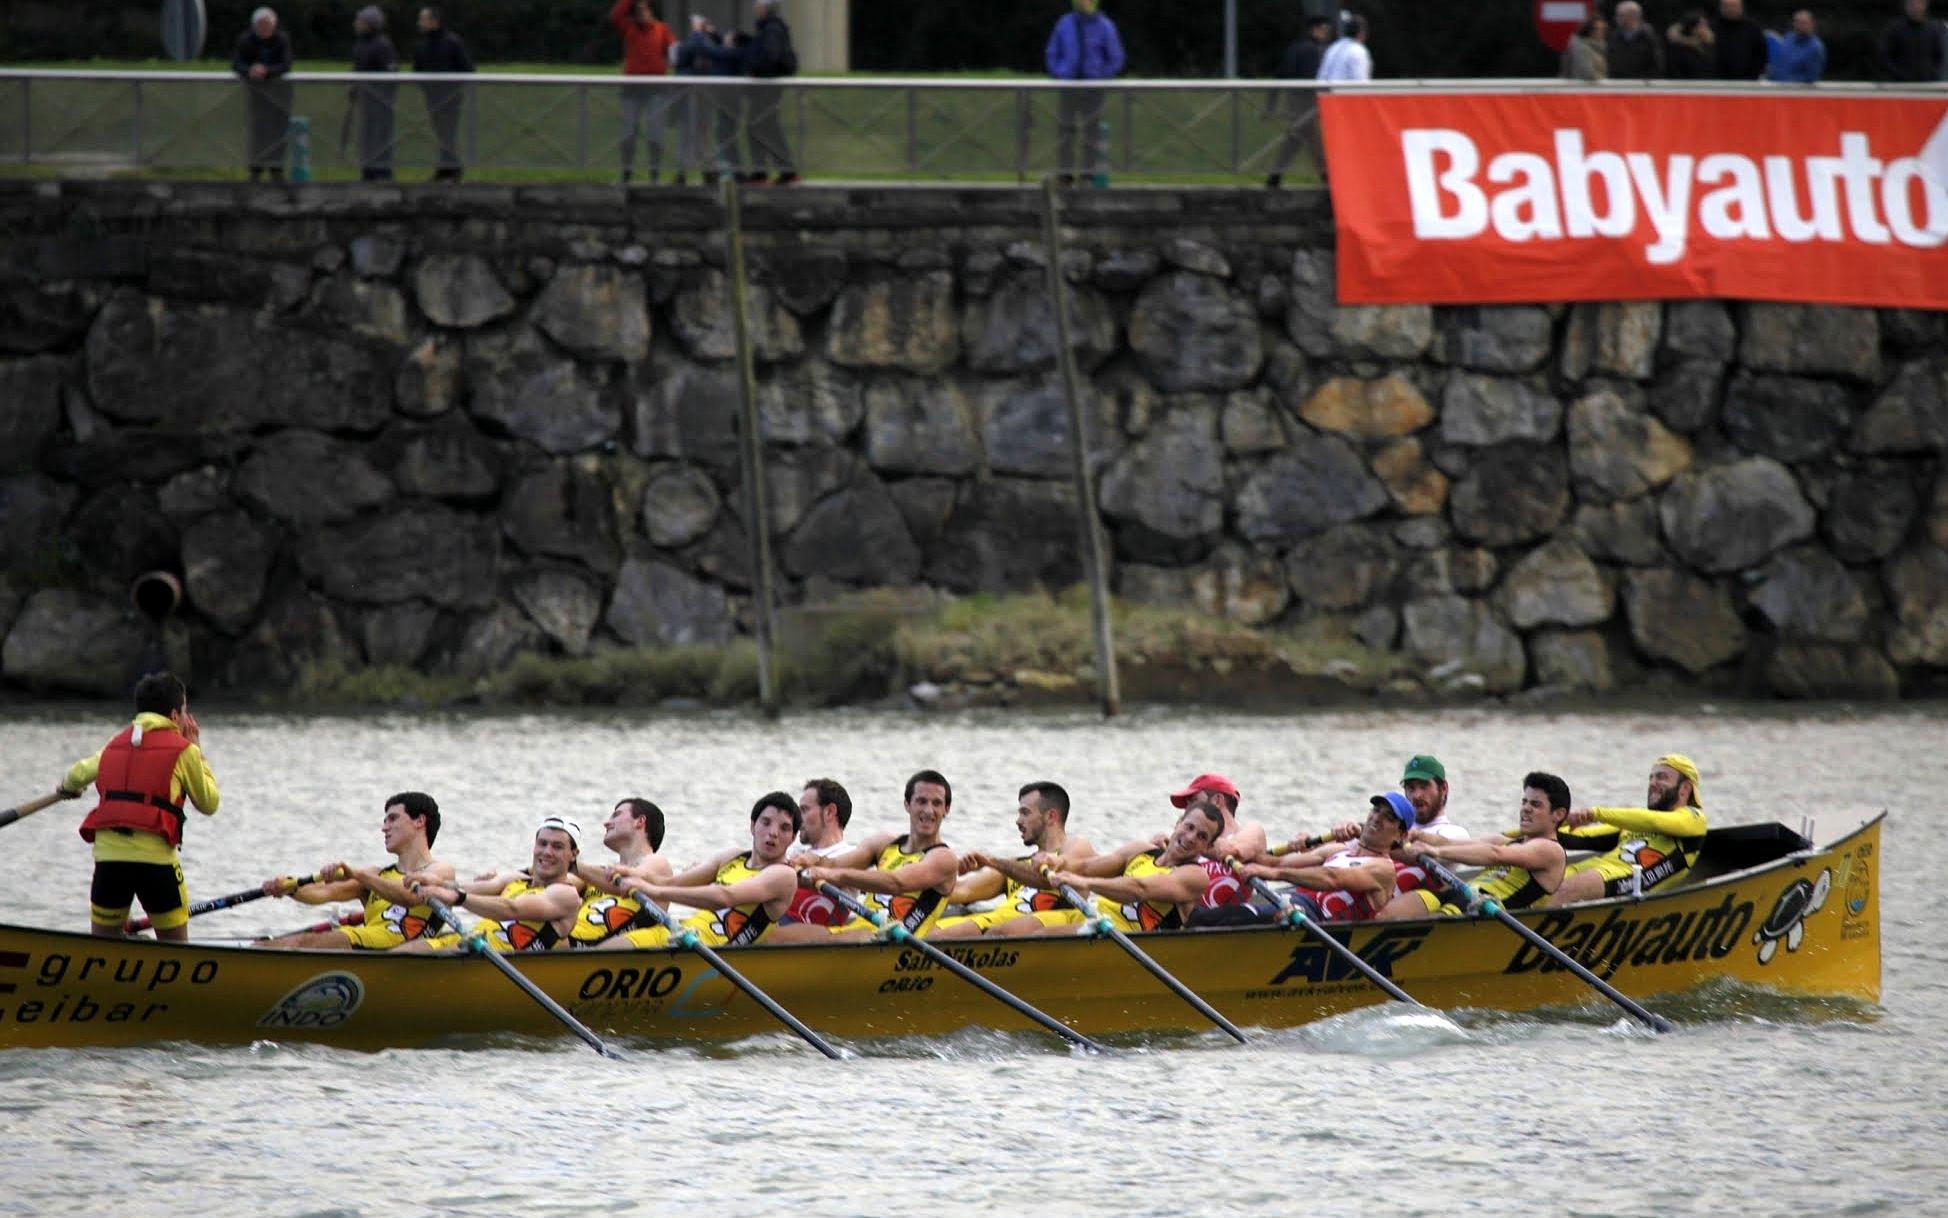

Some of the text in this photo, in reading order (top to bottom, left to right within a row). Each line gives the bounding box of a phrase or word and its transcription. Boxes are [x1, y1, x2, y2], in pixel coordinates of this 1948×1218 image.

[1402, 128, 1948, 264] Babyauto
[1506, 894, 1754, 981] Babyauto
[37, 953, 218, 990] grupo
[579, 967, 682, 1000] ORIO
[15, 996, 168, 1023] eibar
